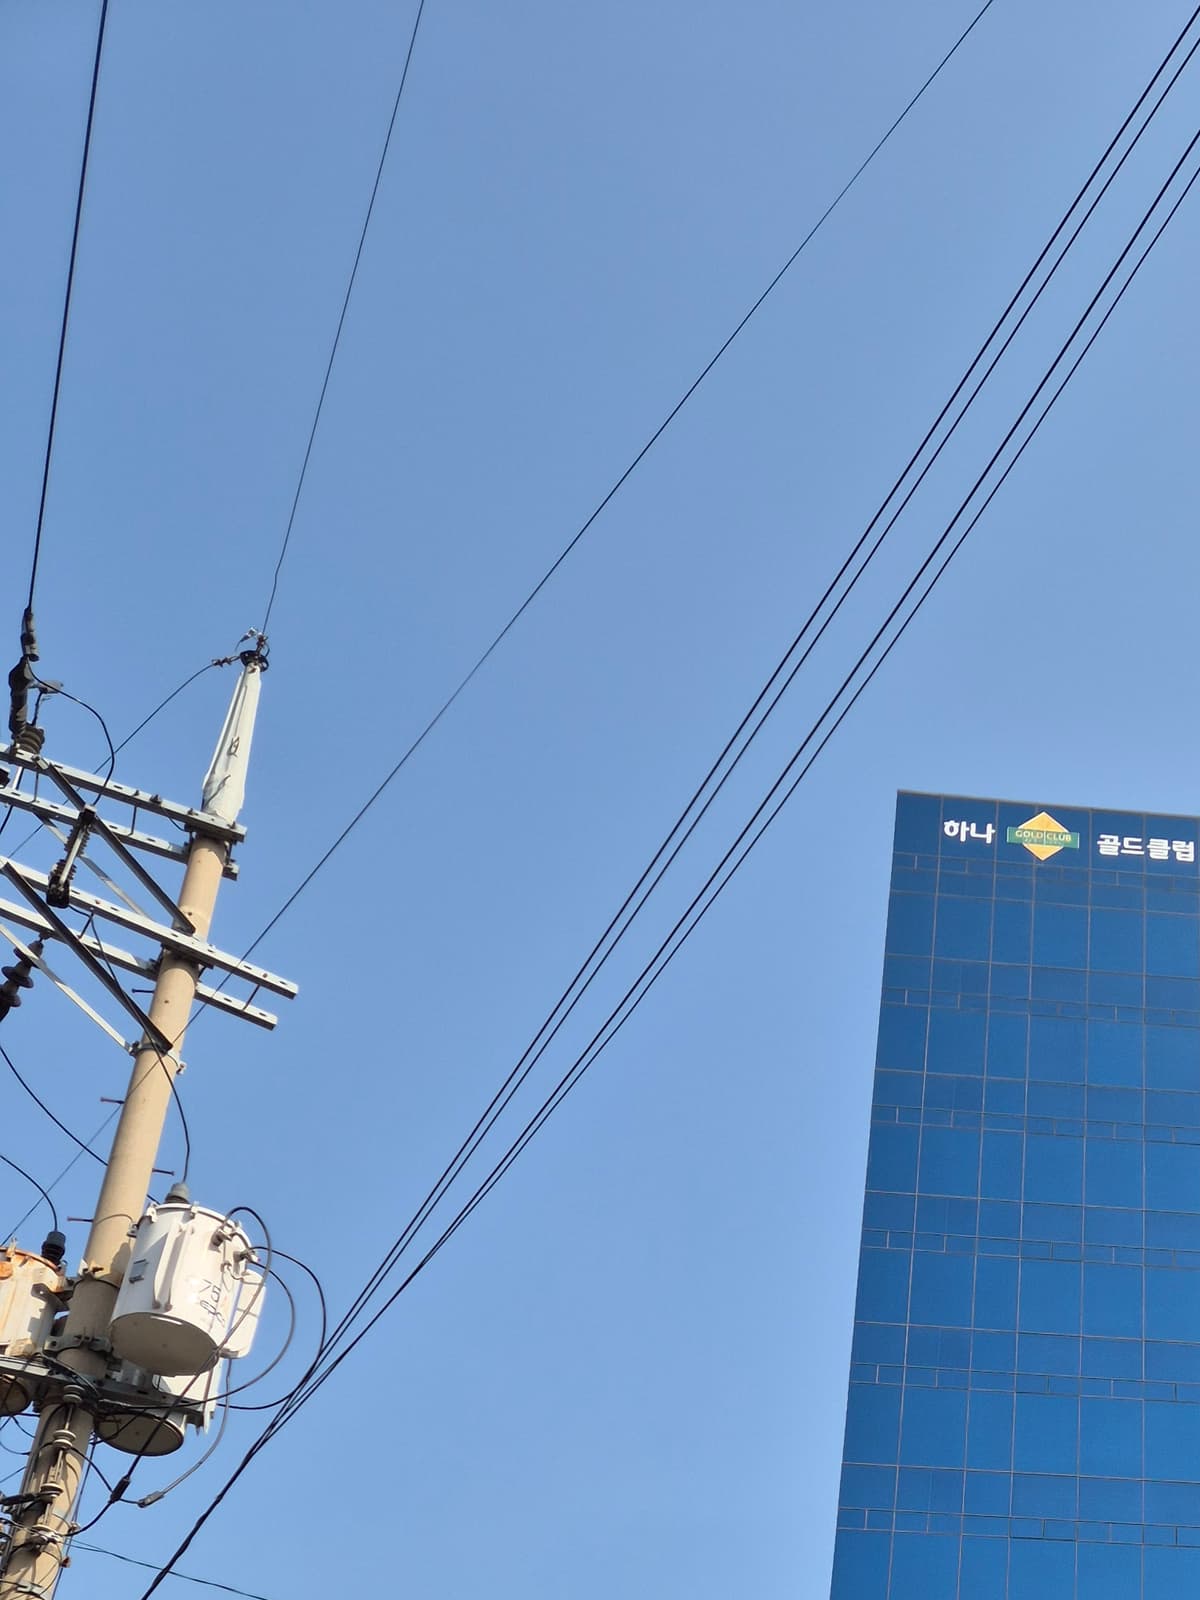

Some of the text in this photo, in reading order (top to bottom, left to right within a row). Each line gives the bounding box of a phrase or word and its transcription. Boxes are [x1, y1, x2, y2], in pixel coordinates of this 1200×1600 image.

[944, 820, 995, 844] 하나
[1015, 830, 1044, 840] GOLD
[1046, 832, 1072, 842] CLUB
[1097, 834, 1195, 863] 골드클럽
